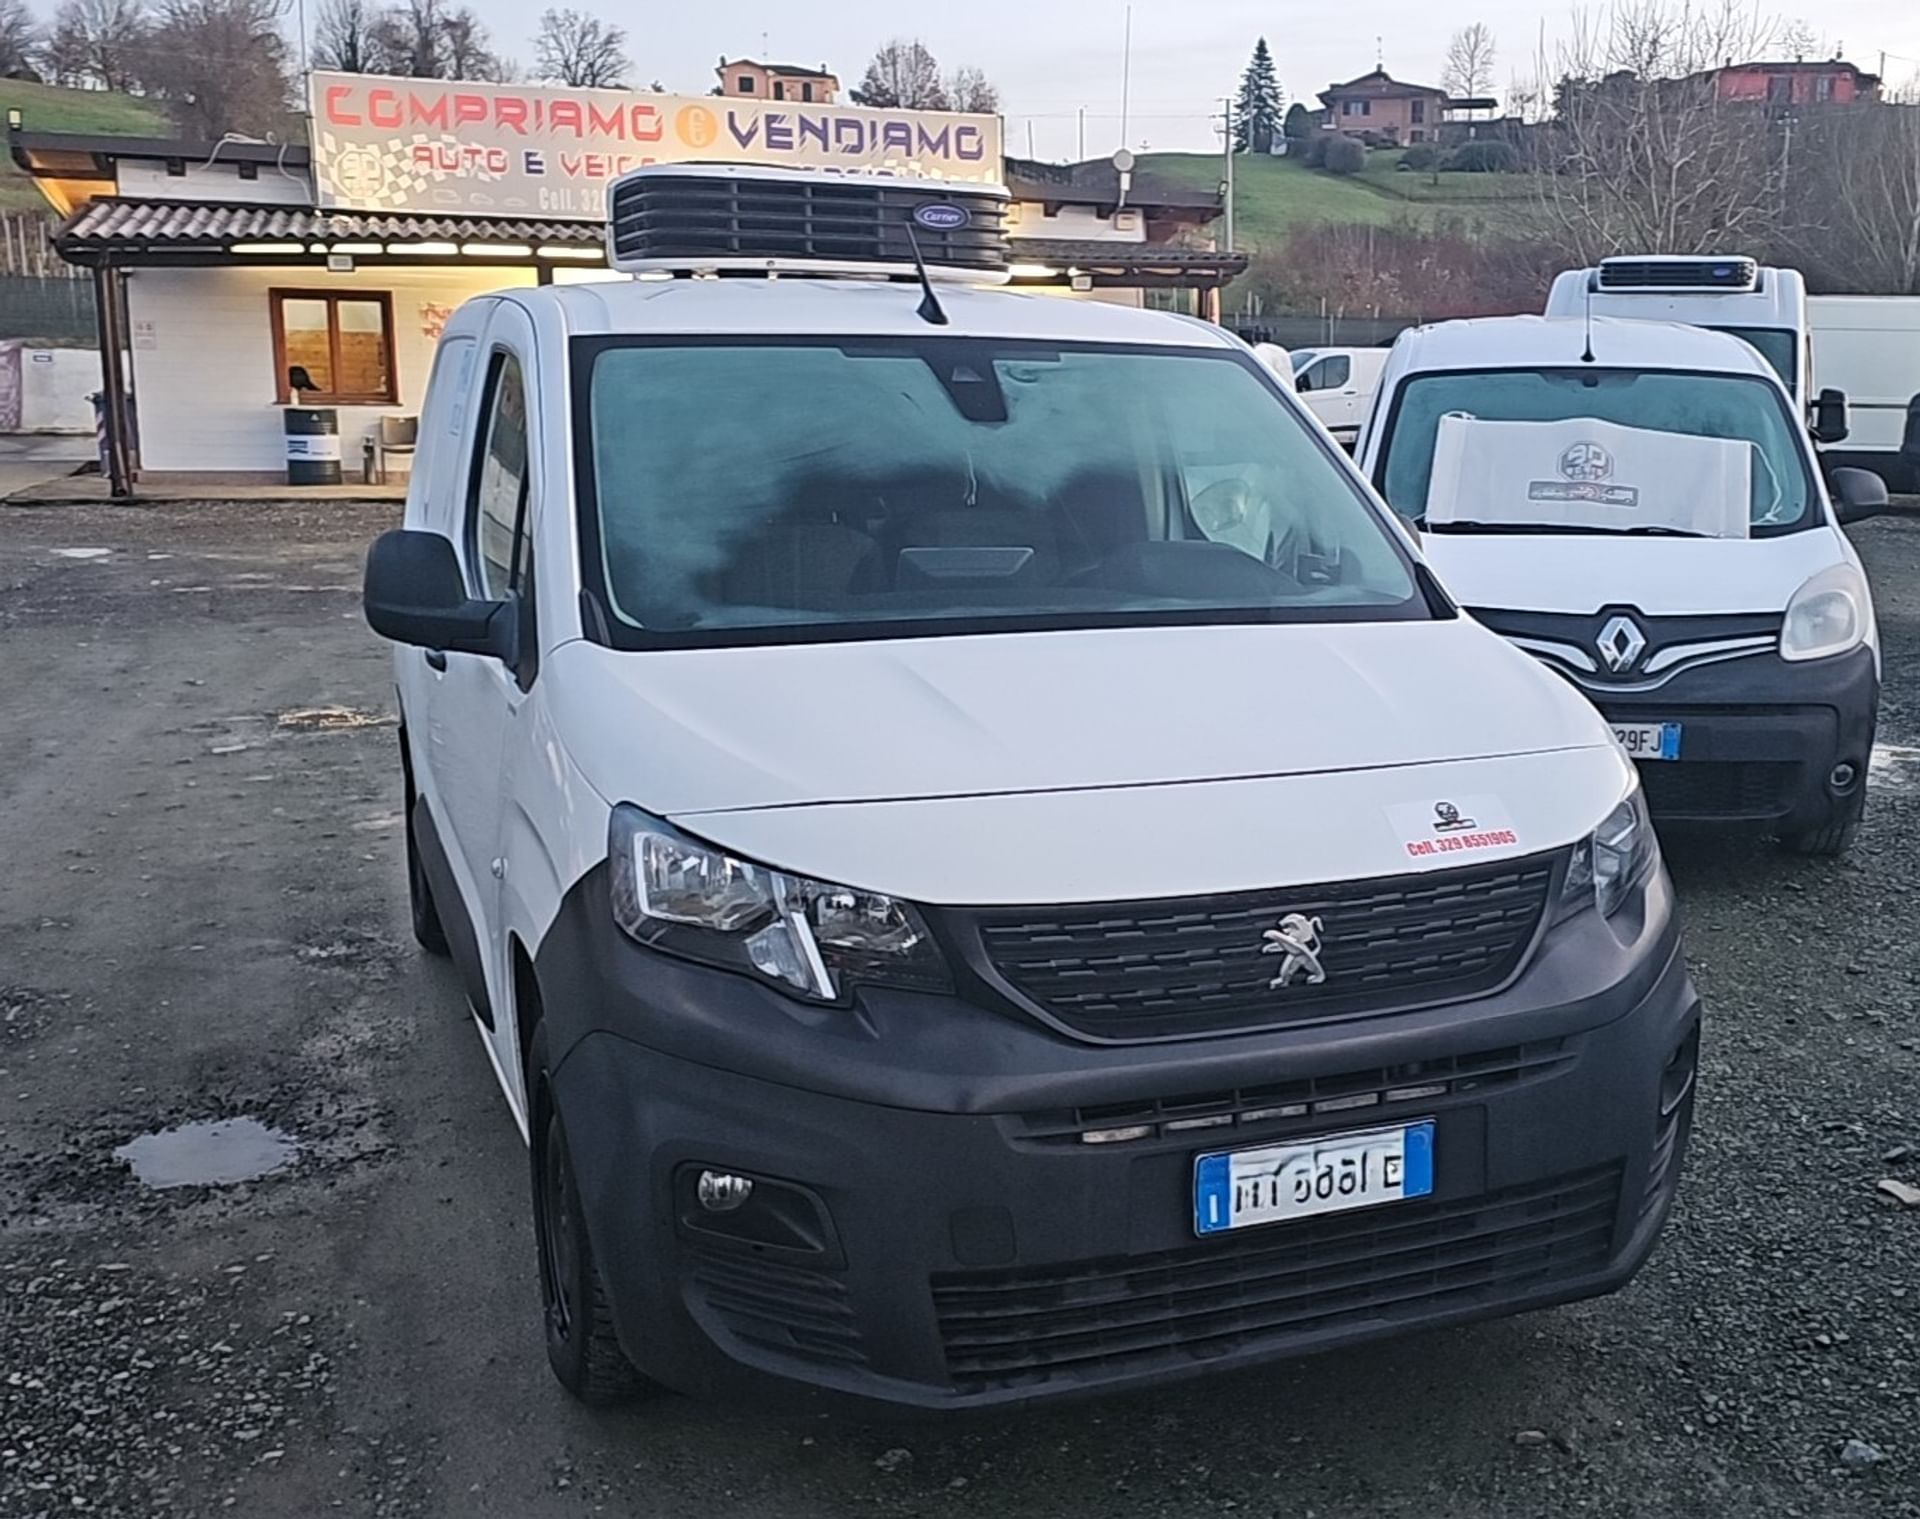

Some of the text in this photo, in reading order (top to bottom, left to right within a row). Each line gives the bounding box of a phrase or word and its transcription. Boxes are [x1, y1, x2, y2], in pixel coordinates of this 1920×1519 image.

[325, 85, 663, 141] COMPRIAMO
[727, 108, 984, 161] VENDIAMO
[412, 146, 657, 177] AUTO E VEIC
[539, 186, 604, 212] Cell. 32
[1612, 729, 1662, 752] 29FJ
[1436, 837, 1463, 853] 329
[1464, 830, 1517, 849] 8551905
